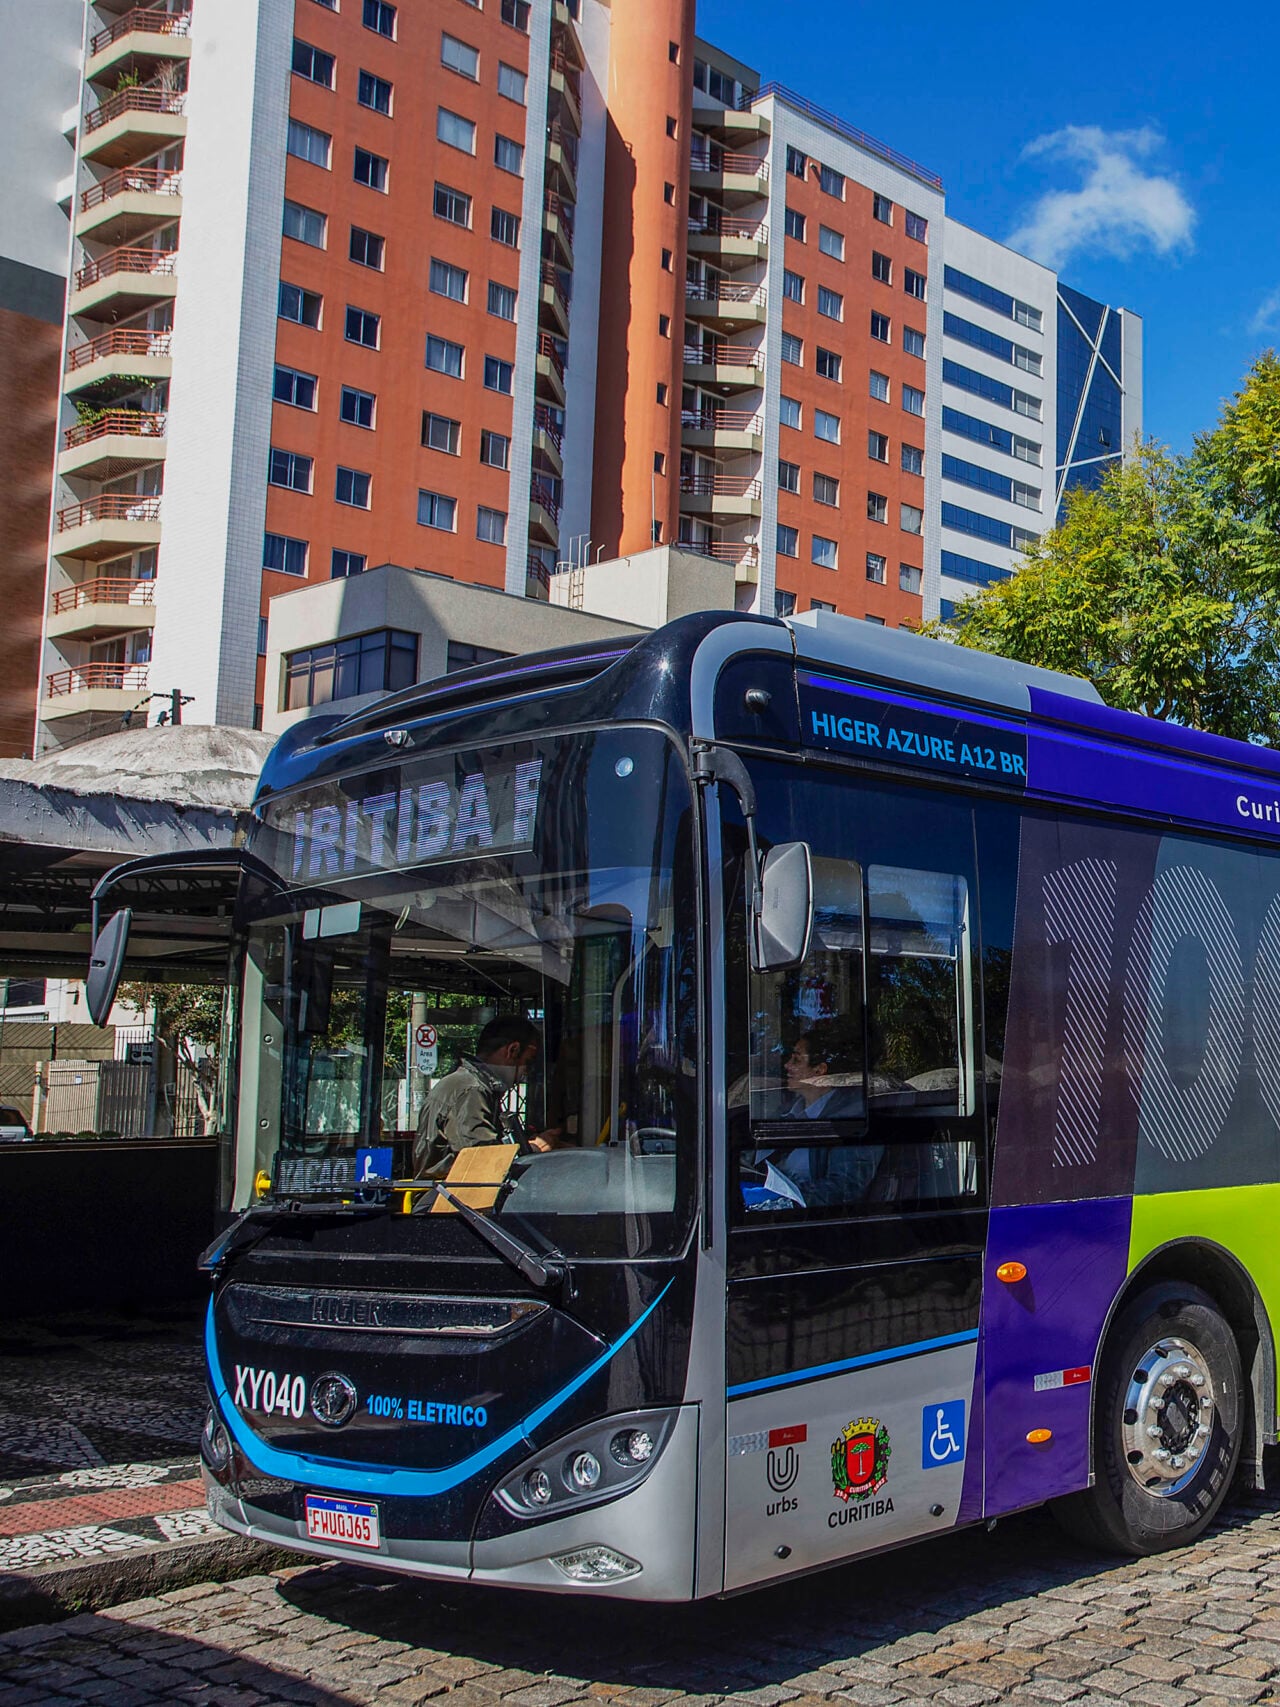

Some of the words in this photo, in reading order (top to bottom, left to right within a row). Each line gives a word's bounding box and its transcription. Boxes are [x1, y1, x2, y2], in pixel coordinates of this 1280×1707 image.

[811, 710, 883, 748] HIGER
[886, 727, 957, 763] AZURE
[959, 743, 997, 771] A12
[1000, 751, 1027, 777] BR
[311, 1295, 384, 1327] HIGER
[234, 1364, 307, 1419] XY040
[366, 1393, 404, 1420] 100%
[407, 1399, 488, 1428] ELETRICO
[766, 1496, 799, 1517] urbs
[827, 1497, 895, 1529] CURITIBA
